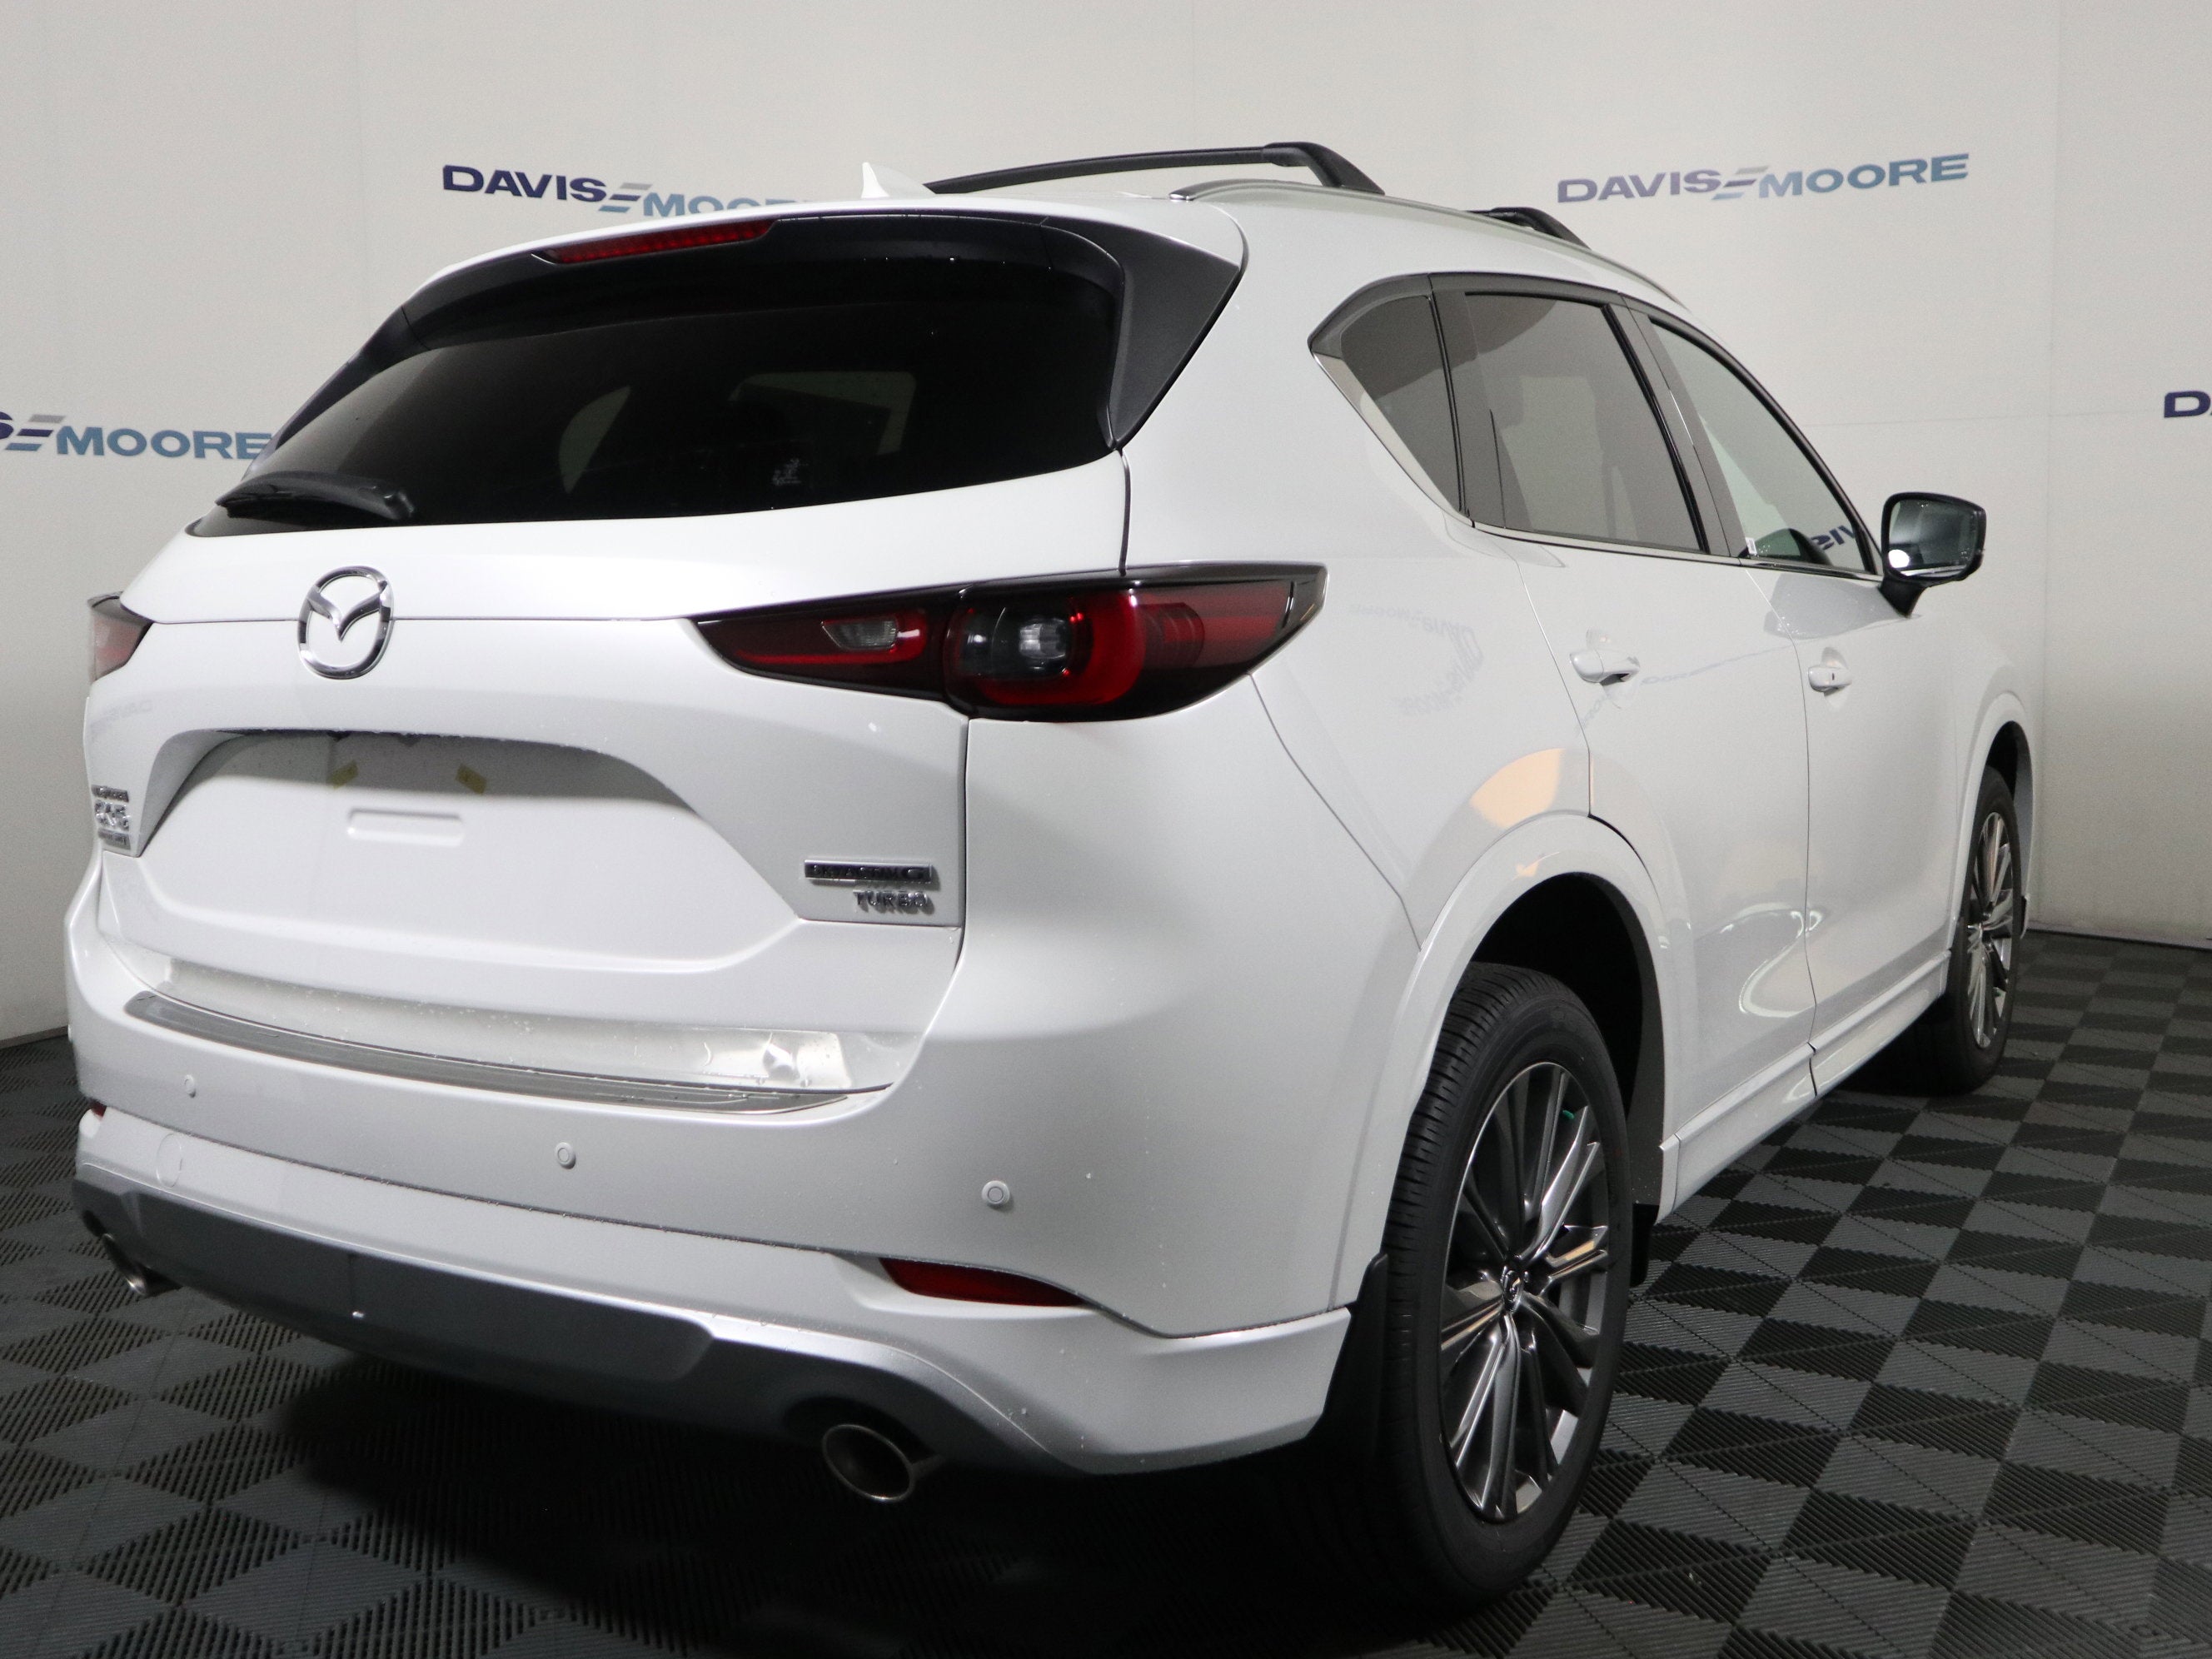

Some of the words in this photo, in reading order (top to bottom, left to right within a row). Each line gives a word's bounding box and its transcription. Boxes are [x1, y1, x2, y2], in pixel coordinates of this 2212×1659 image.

[442, 164, 607, 202] DAVIS
[1557, 170, 1723, 203] DAVIS
[1759, 153, 1970, 199] MOORE
[56, 426, 272, 460] MOORE
[852, 889, 929, 907] TURBO
